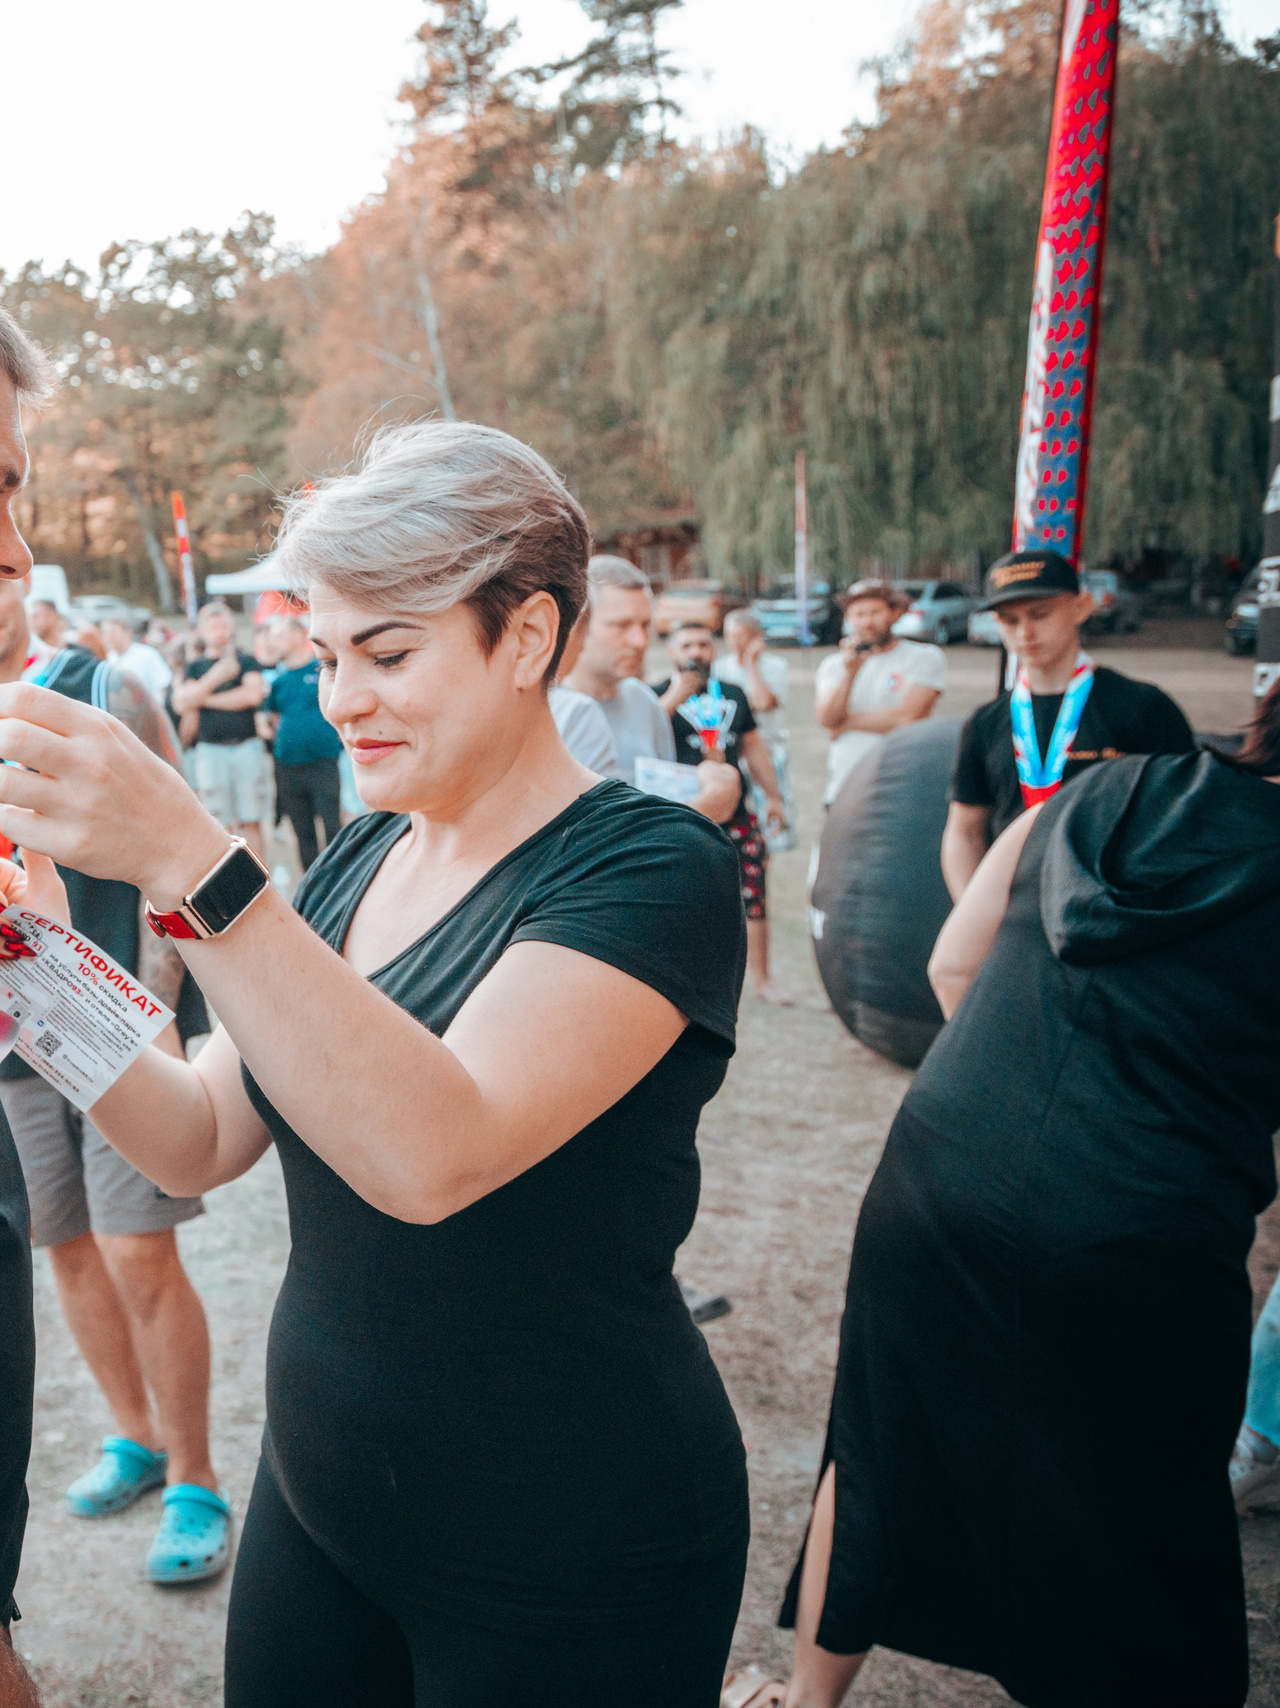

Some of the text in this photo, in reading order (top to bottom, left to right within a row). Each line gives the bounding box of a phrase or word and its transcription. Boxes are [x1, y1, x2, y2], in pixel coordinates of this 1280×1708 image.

[19, 911, 163, 1017] СЕРТИФИКАТ
[32, 941, 43, 952] 93
[49, 953, 59, 963] на
[57, 960, 82, 985] услуги
[81, 982, 99, 1000] базы
[97, 998, 141, 1038] драйв-парка
[77, 962, 100, 986] 10%
[98, 984, 128, 1013] скидка
[90, 1003, 111, 1023] отеля
